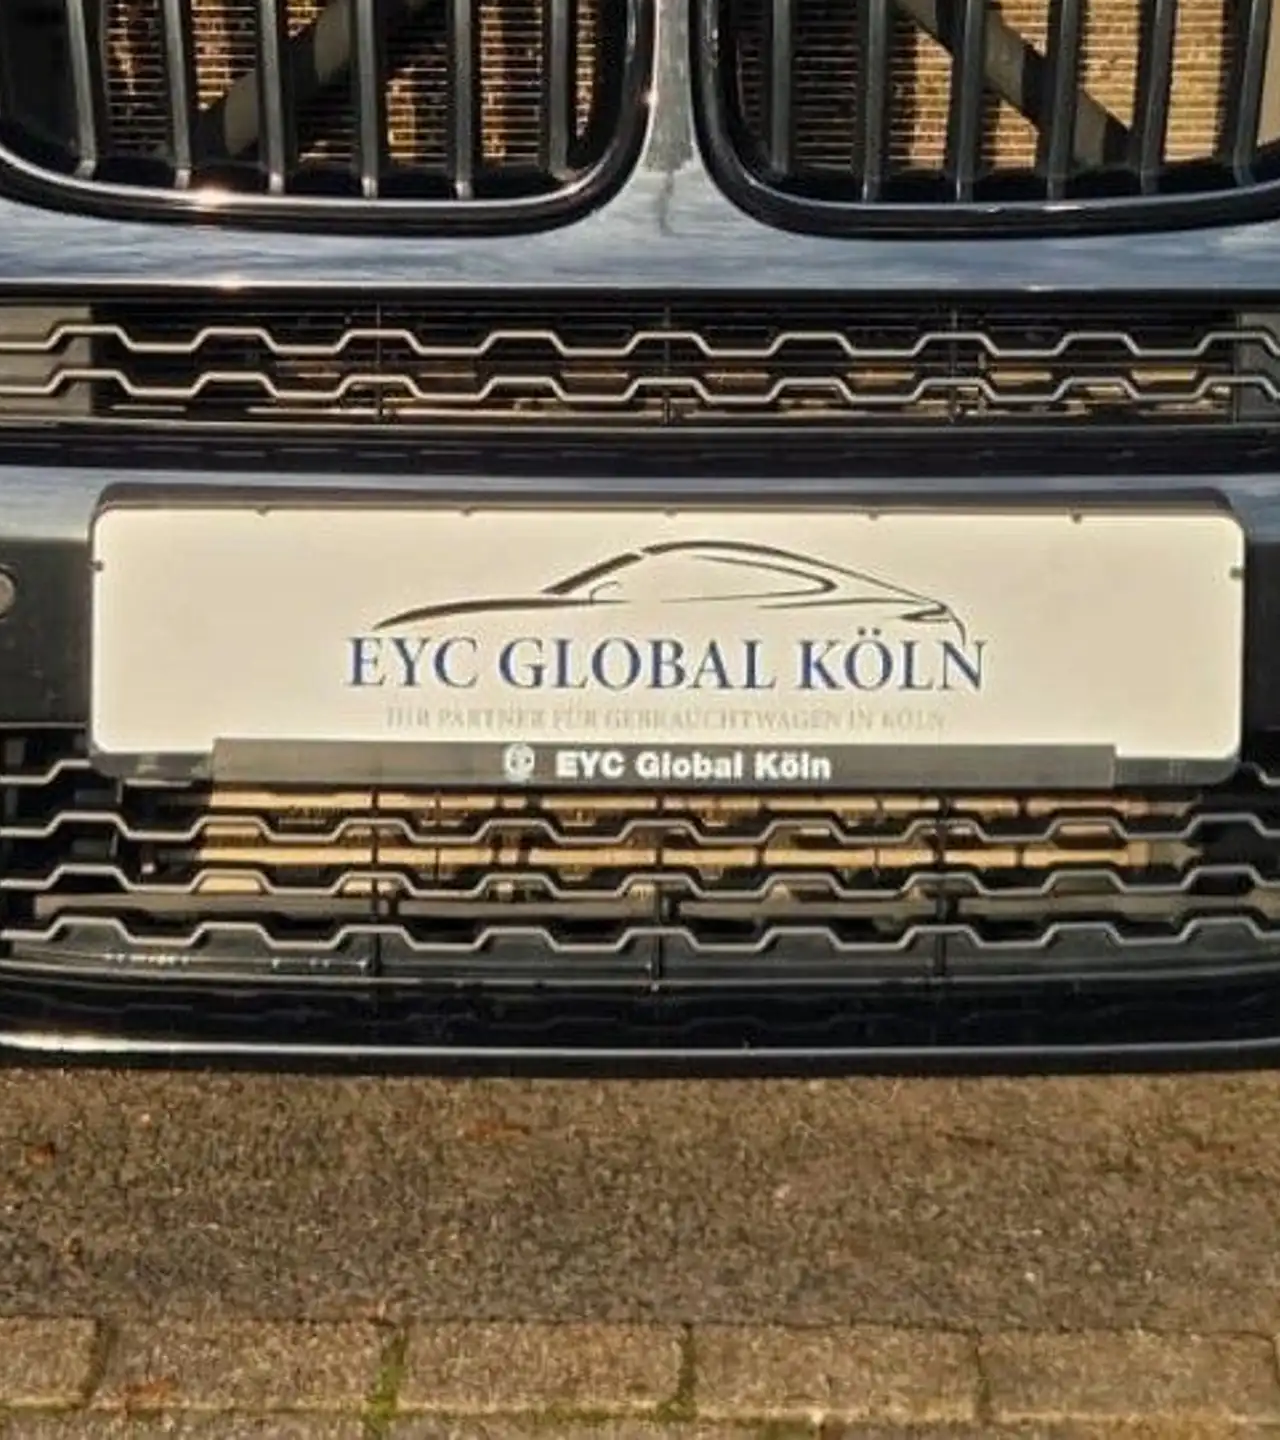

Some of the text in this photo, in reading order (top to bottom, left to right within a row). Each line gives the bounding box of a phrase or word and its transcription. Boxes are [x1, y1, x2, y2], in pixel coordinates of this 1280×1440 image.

[349, 626, 987, 690] EYC GLOBAL KÖLN
[556, 750, 832, 779] EYC Global Köln
